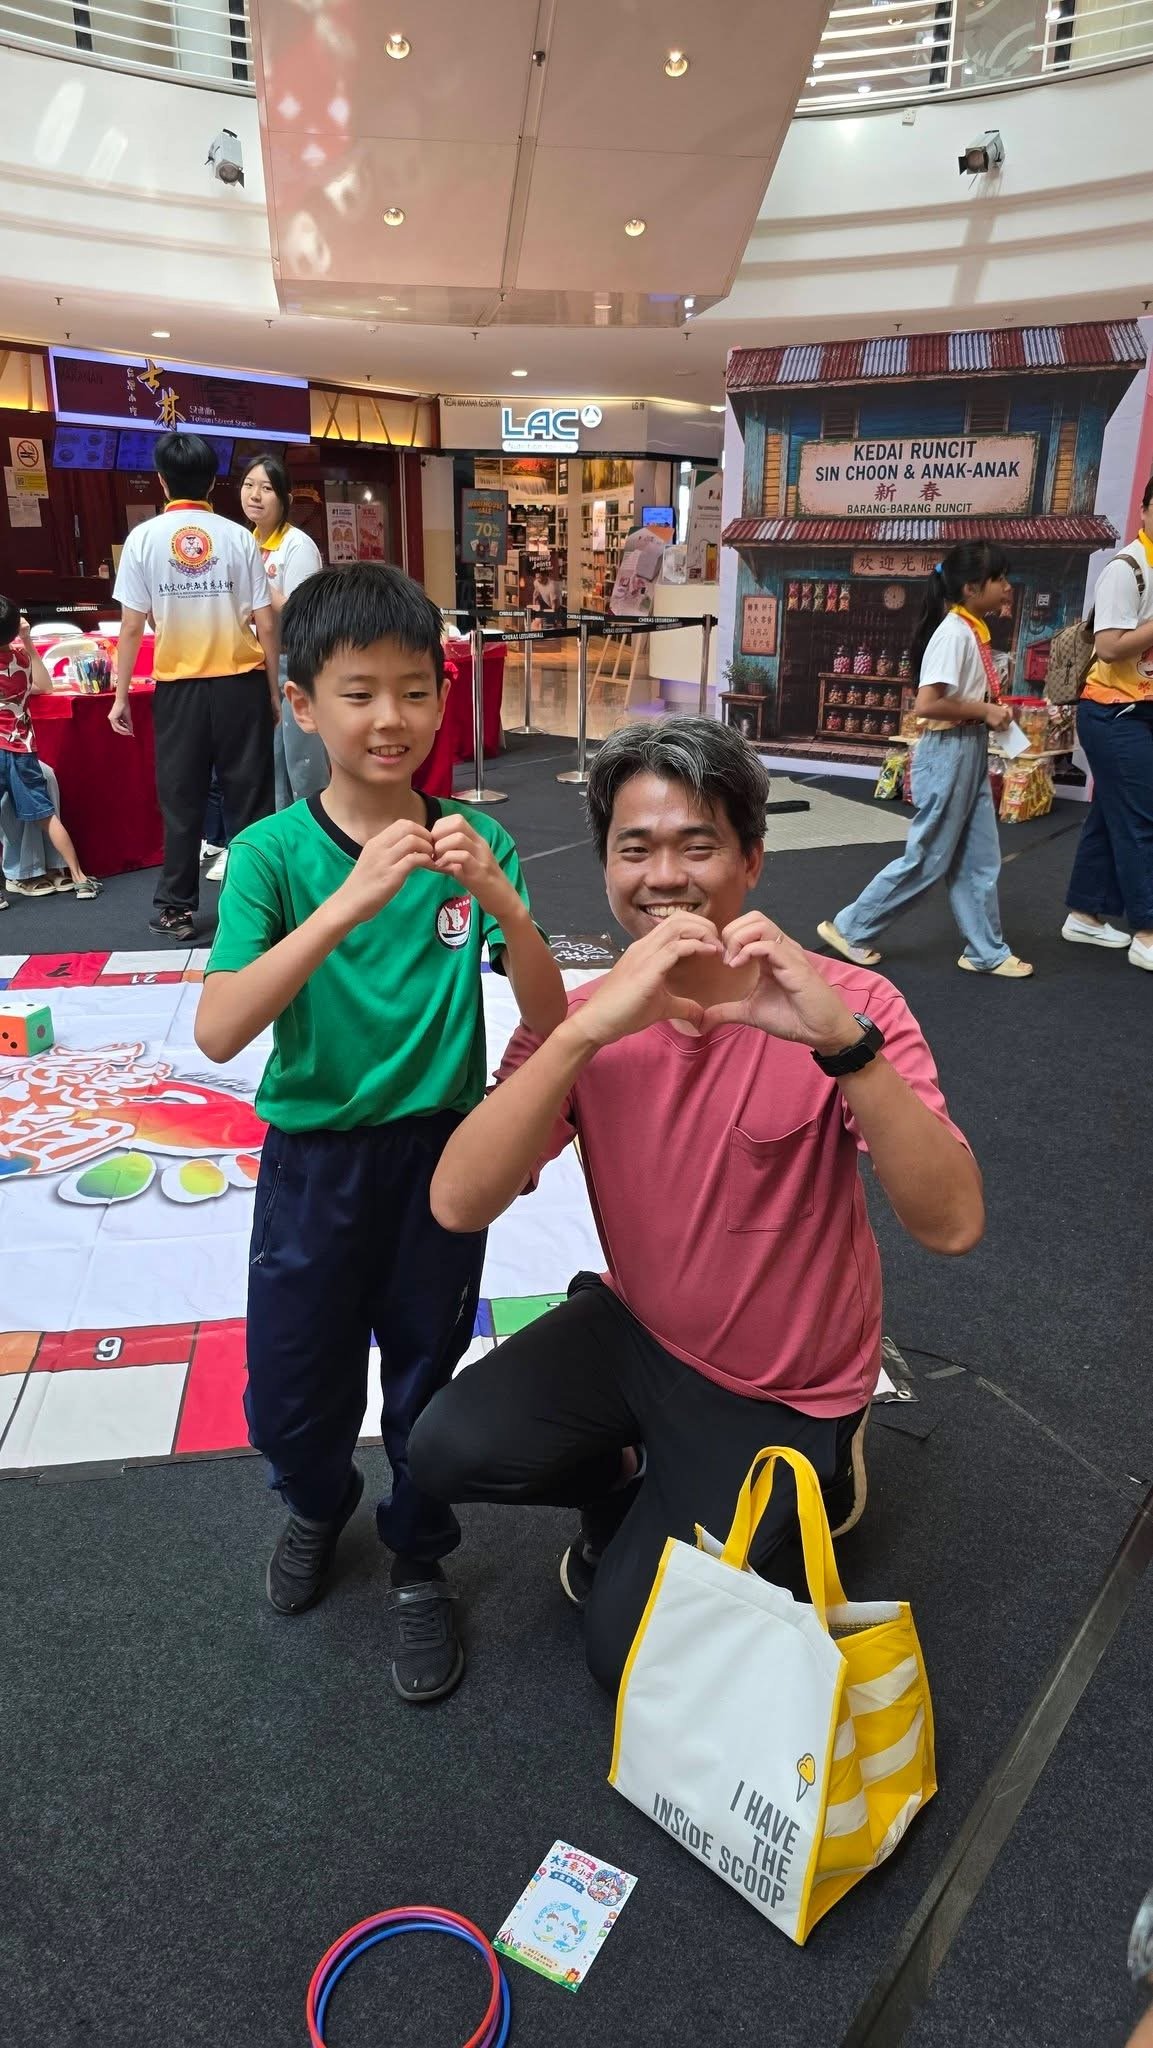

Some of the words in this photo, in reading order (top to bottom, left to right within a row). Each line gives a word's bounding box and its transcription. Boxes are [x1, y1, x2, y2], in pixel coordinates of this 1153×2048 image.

[502, 408, 579, 440] LAC
[854, 443, 903, 461] KEDAI
[910, 440, 977, 460] RUNCIT
[815, 466, 840, 482] SIN
[845, 464, 898, 481] CHOON
[903, 464, 915, 480] &
[921, 461, 1021, 479] ANAK-ANAK
[847, 503, 931, 514] BARANG-BARANG
[935, 503, 972, 513] RUNCIT
[858, 554, 936, 572] 欢迎光临
[95, 1336, 124, 1362] 9
[730, 1780, 745, 1812] I
[743, 1790, 800, 1855] HAVE
[653, 1792, 714, 1860] INSIDE
[718, 1845, 785, 1909] SCOOP
[751, 1834, 792, 1886] THE
